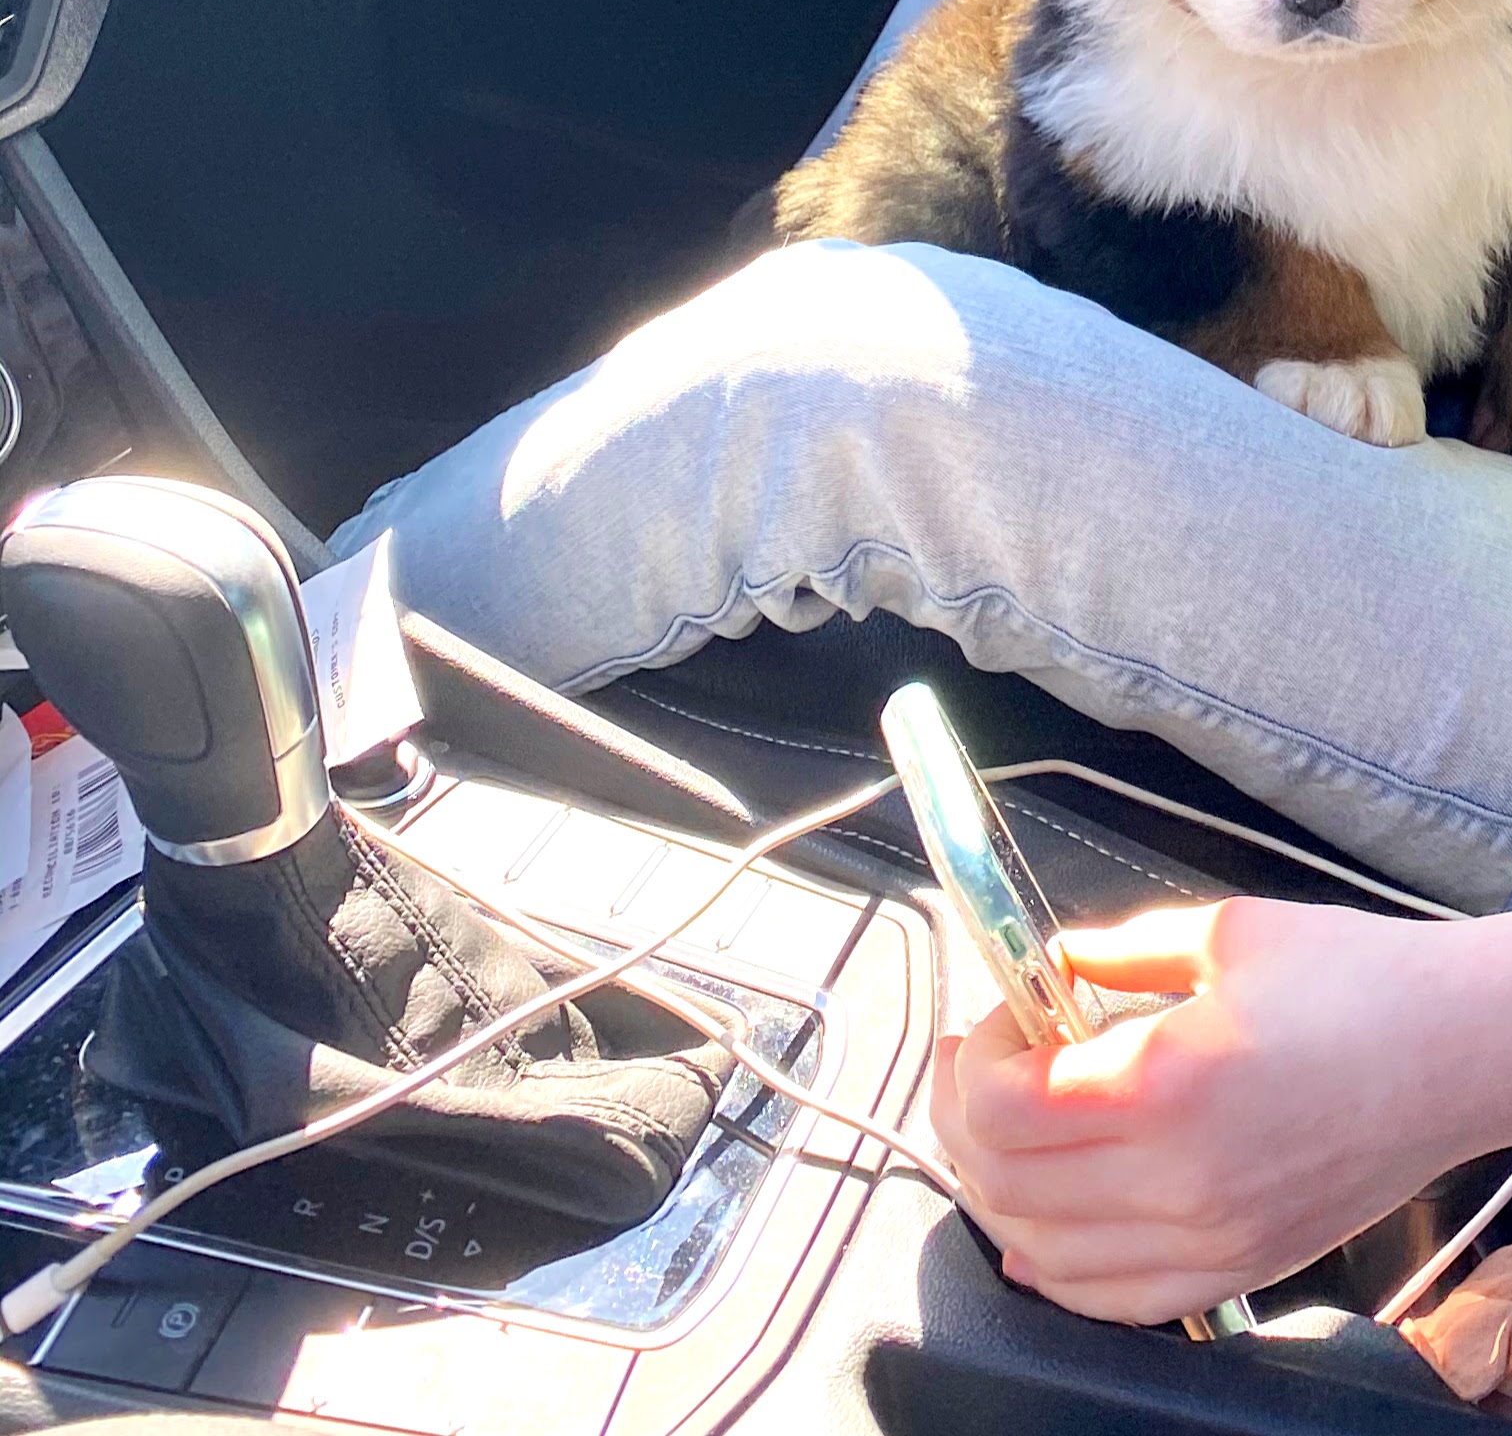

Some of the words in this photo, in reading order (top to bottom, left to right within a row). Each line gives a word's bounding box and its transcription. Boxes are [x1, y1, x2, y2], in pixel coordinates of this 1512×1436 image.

[293, 1198, 325, 1217] R
[358, 1212, 390, 1234] N
[404, 1215, 446, 1260] D/S
